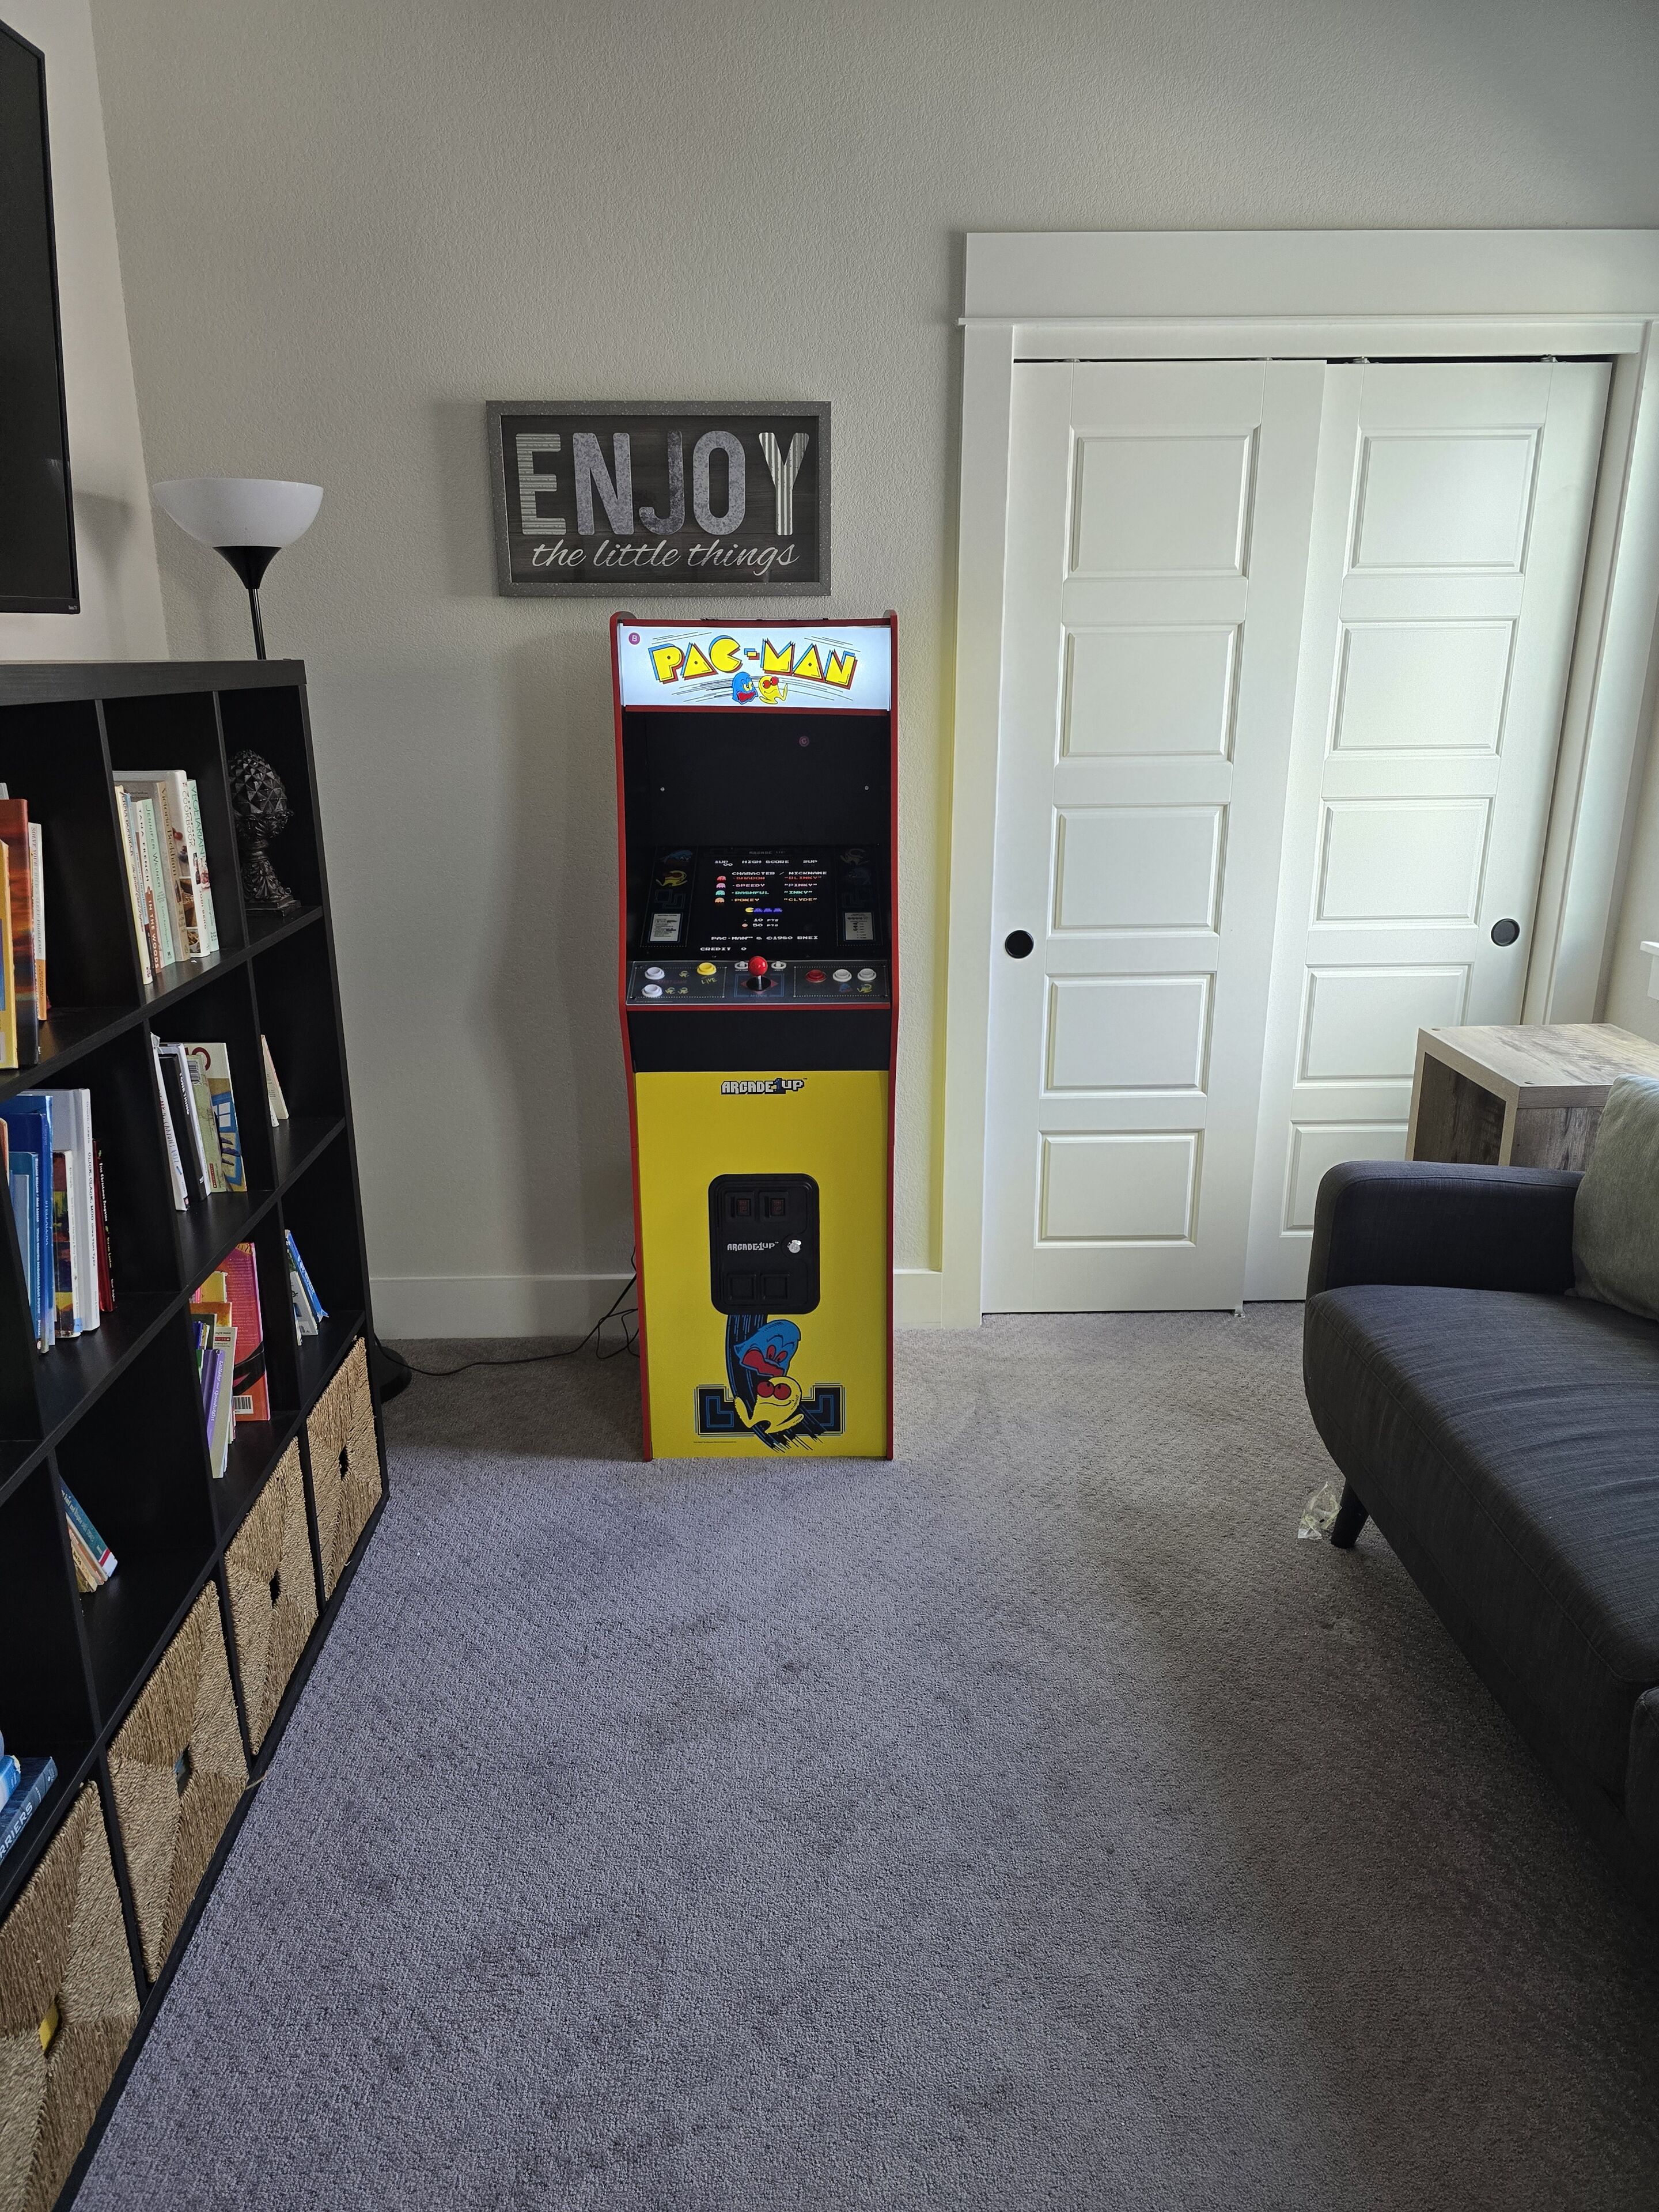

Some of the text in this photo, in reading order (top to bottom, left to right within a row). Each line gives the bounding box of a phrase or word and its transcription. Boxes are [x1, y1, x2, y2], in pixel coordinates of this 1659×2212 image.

[516, 430, 809, 535] ENJOY
[532, 539, 800, 576] the little things
[648, 635, 858, 690] PAC-MAN
[161, 787, 171, 826] Victoria
[182, 790, 194, 847] COOKBOOK
[191, 786, 205, 855] VEGETARIAN
[145, 804, 156, 850] JENNIFER
[152, 853, 162, 888] WEINER
[148, 900, 152, 910] IN
